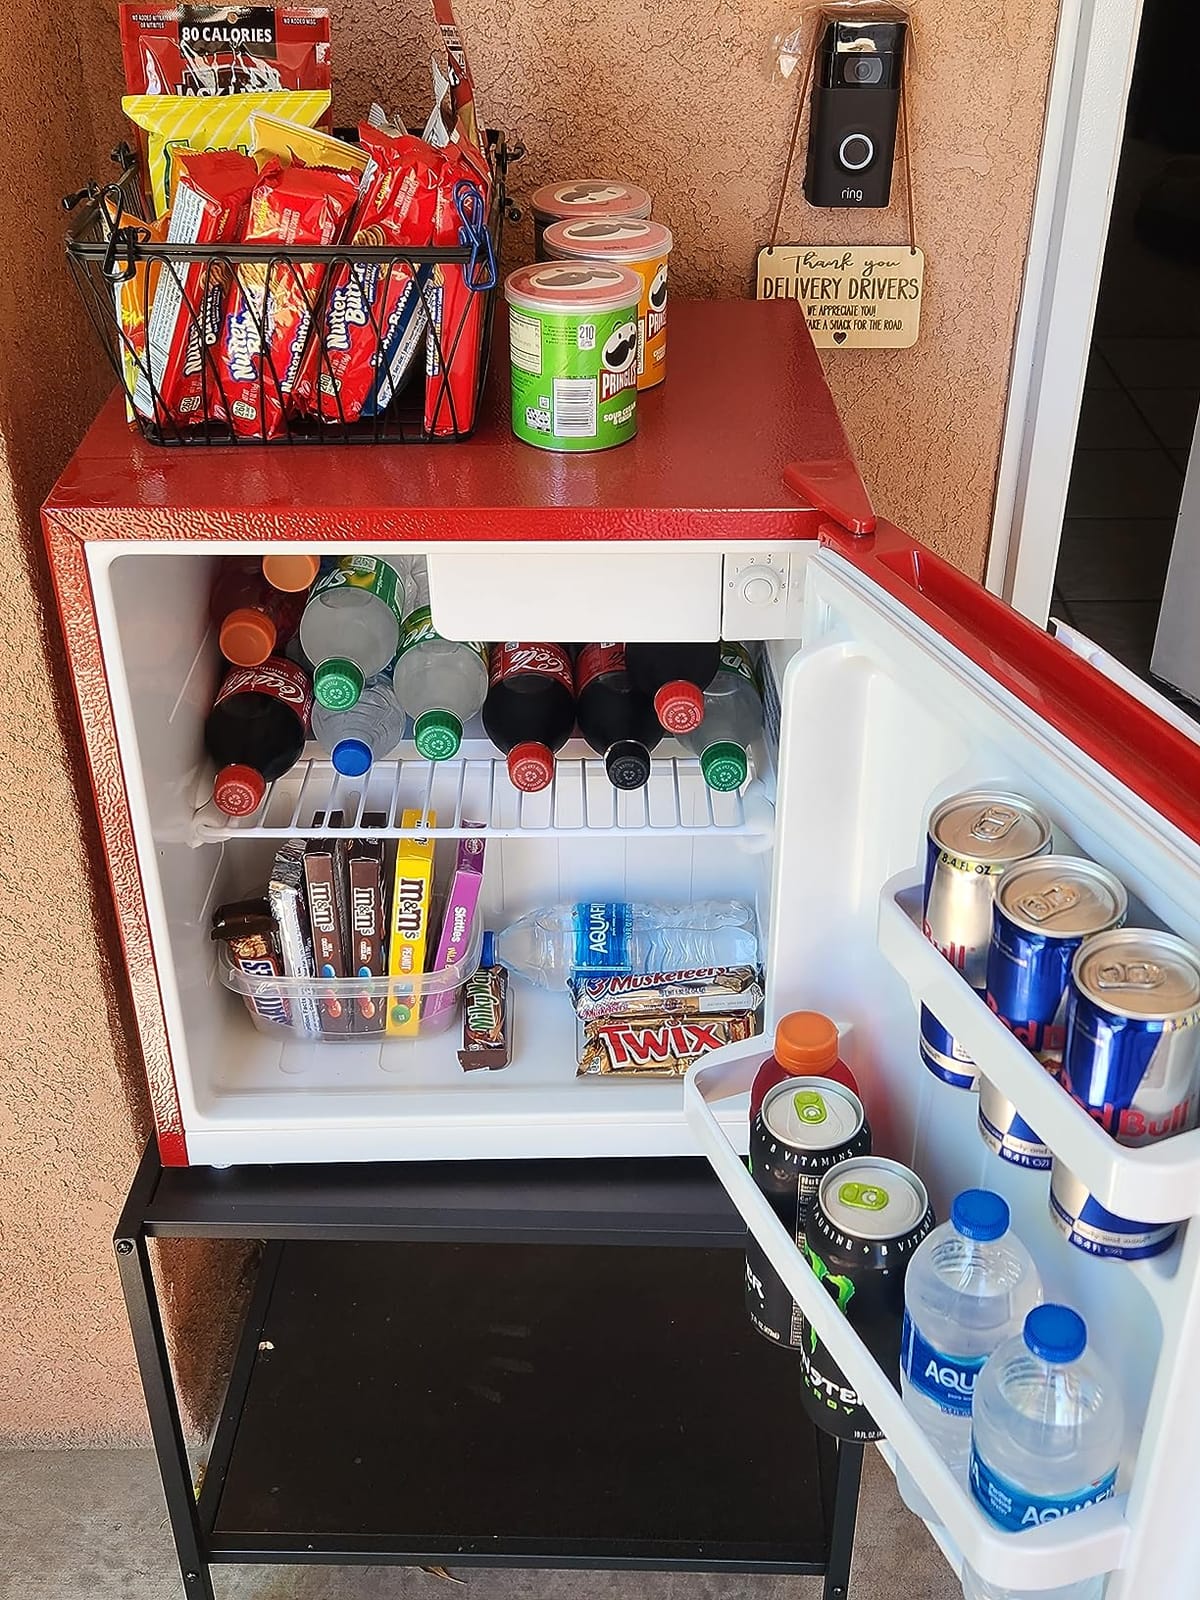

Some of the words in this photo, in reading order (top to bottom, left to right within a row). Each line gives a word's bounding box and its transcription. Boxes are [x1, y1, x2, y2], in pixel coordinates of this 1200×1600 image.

[182, 27, 200, 42] 80
[202, 28, 272, 43] CALORIES
[841, 187, 863, 202] ring
[782, 251, 853, 275] Thank
[862, 258, 901, 277] you
[346, 262, 366, 325] Butter
[763, 277, 842, 300] DELIVERY
[849, 277, 920, 300] DRIVERS
[327, 290, 348, 350] Nutter
[819, 305, 859, 317] APPRECIATE
[860, 305, 876, 317] YOU!
[822, 320, 828, 331] A
[829, 320, 852, 331] SNACK
[853, 320, 868, 331] FOR
[868, 320, 882, 331] THE
[883, 320, 904, 331] ROAD.
[229, 316, 258, 380] Nutter
[580, 326, 594, 340] 210
[281, 351, 300, 392] Nutter
[602, 361, 637, 399] PRINGLES
[941, 852, 958, 868] 8.4
[958, 859, 970, 872] FL
[974, 865, 992, 876] OZ
[452, 906, 466, 943] Skittles
[588, 903, 610, 954] AQUAFI
[402, 947, 414, 970] PEANUT
[586, 976, 608, 996] 3
[610, 966, 729, 993] Musketeers
[1119, 1099, 1190, 1137] Bull
[770, 1144, 777, 1153] B
[784, 1148, 854, 1168] VITAMINS
[812, 1202, 853, 1250] TAURINE
[882, 1245, 888, 1256] B
[898, 1209, 932, 1252] VITAMI
[800, 1344, 864, 1406] NSTE
